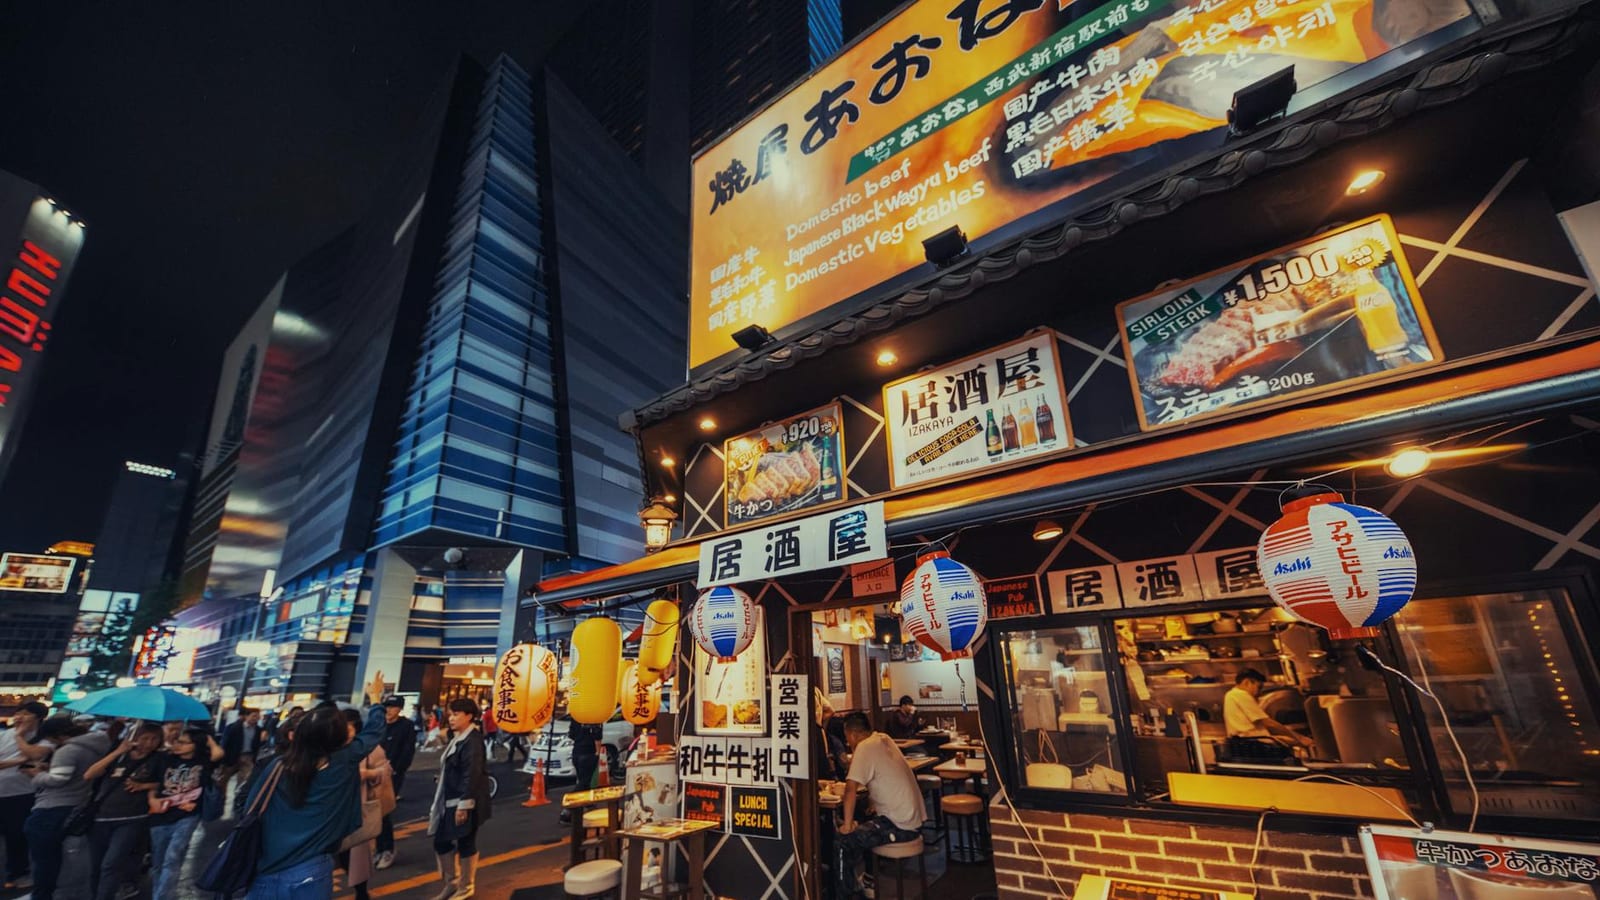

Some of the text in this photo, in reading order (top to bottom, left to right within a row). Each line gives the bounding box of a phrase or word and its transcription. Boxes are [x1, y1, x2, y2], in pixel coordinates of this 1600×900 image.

[900, 97, 966, 148] あおな
[784, 137, 993, 267] Japanese Black Wagyu beef
[786, 158, 912, 242] Domestic beef
[784, 180, 986, 292] Domestic Vegetables
[1130, 294, 1194, 337] SIRLOIN
[1156, 305, 1211, 341] STEAK
[901, 346, 1046, 427] 居酒屋
[1268, 371, 1316, 392] 200g
[907, 419, 976, 465] DELICIOUS COCA-COLA
[908, 416, 954, 438] IZAKAYA
[924, 427, 978, 463] AVAILABLE HERE
[734, 499, 773, 519] 牛かつ
[709, 509, 872, 583] 居酒屋
[1326, 520, 1369, 600] アサヒビール
[856, 566, 891, 582] ENTRANCE
[1065, 550, 1264, 609] 居酒屋
[1273, 556, 1312, 577] Asahi
[866, 582, 883, 595] 入口
[920, 573, 942, 631] アサヒビール
[950, 589, 976, 602] Asahi
[987, 581, 1029, 593] Japanese
[1007, 593, 1025, 603] Pub
[712, 611, 735, 620] Asahi
[991, 602, 1036, 618] IZAKAYA
[496, 649, 523, 725] お食事処
[778, 677, 801, 774] 営業中
[680, 743, 774, 783] 和牛牛排
[734, 812, 774, 829] SPECIAL
[739, 795, 768, 810] LUNCH
